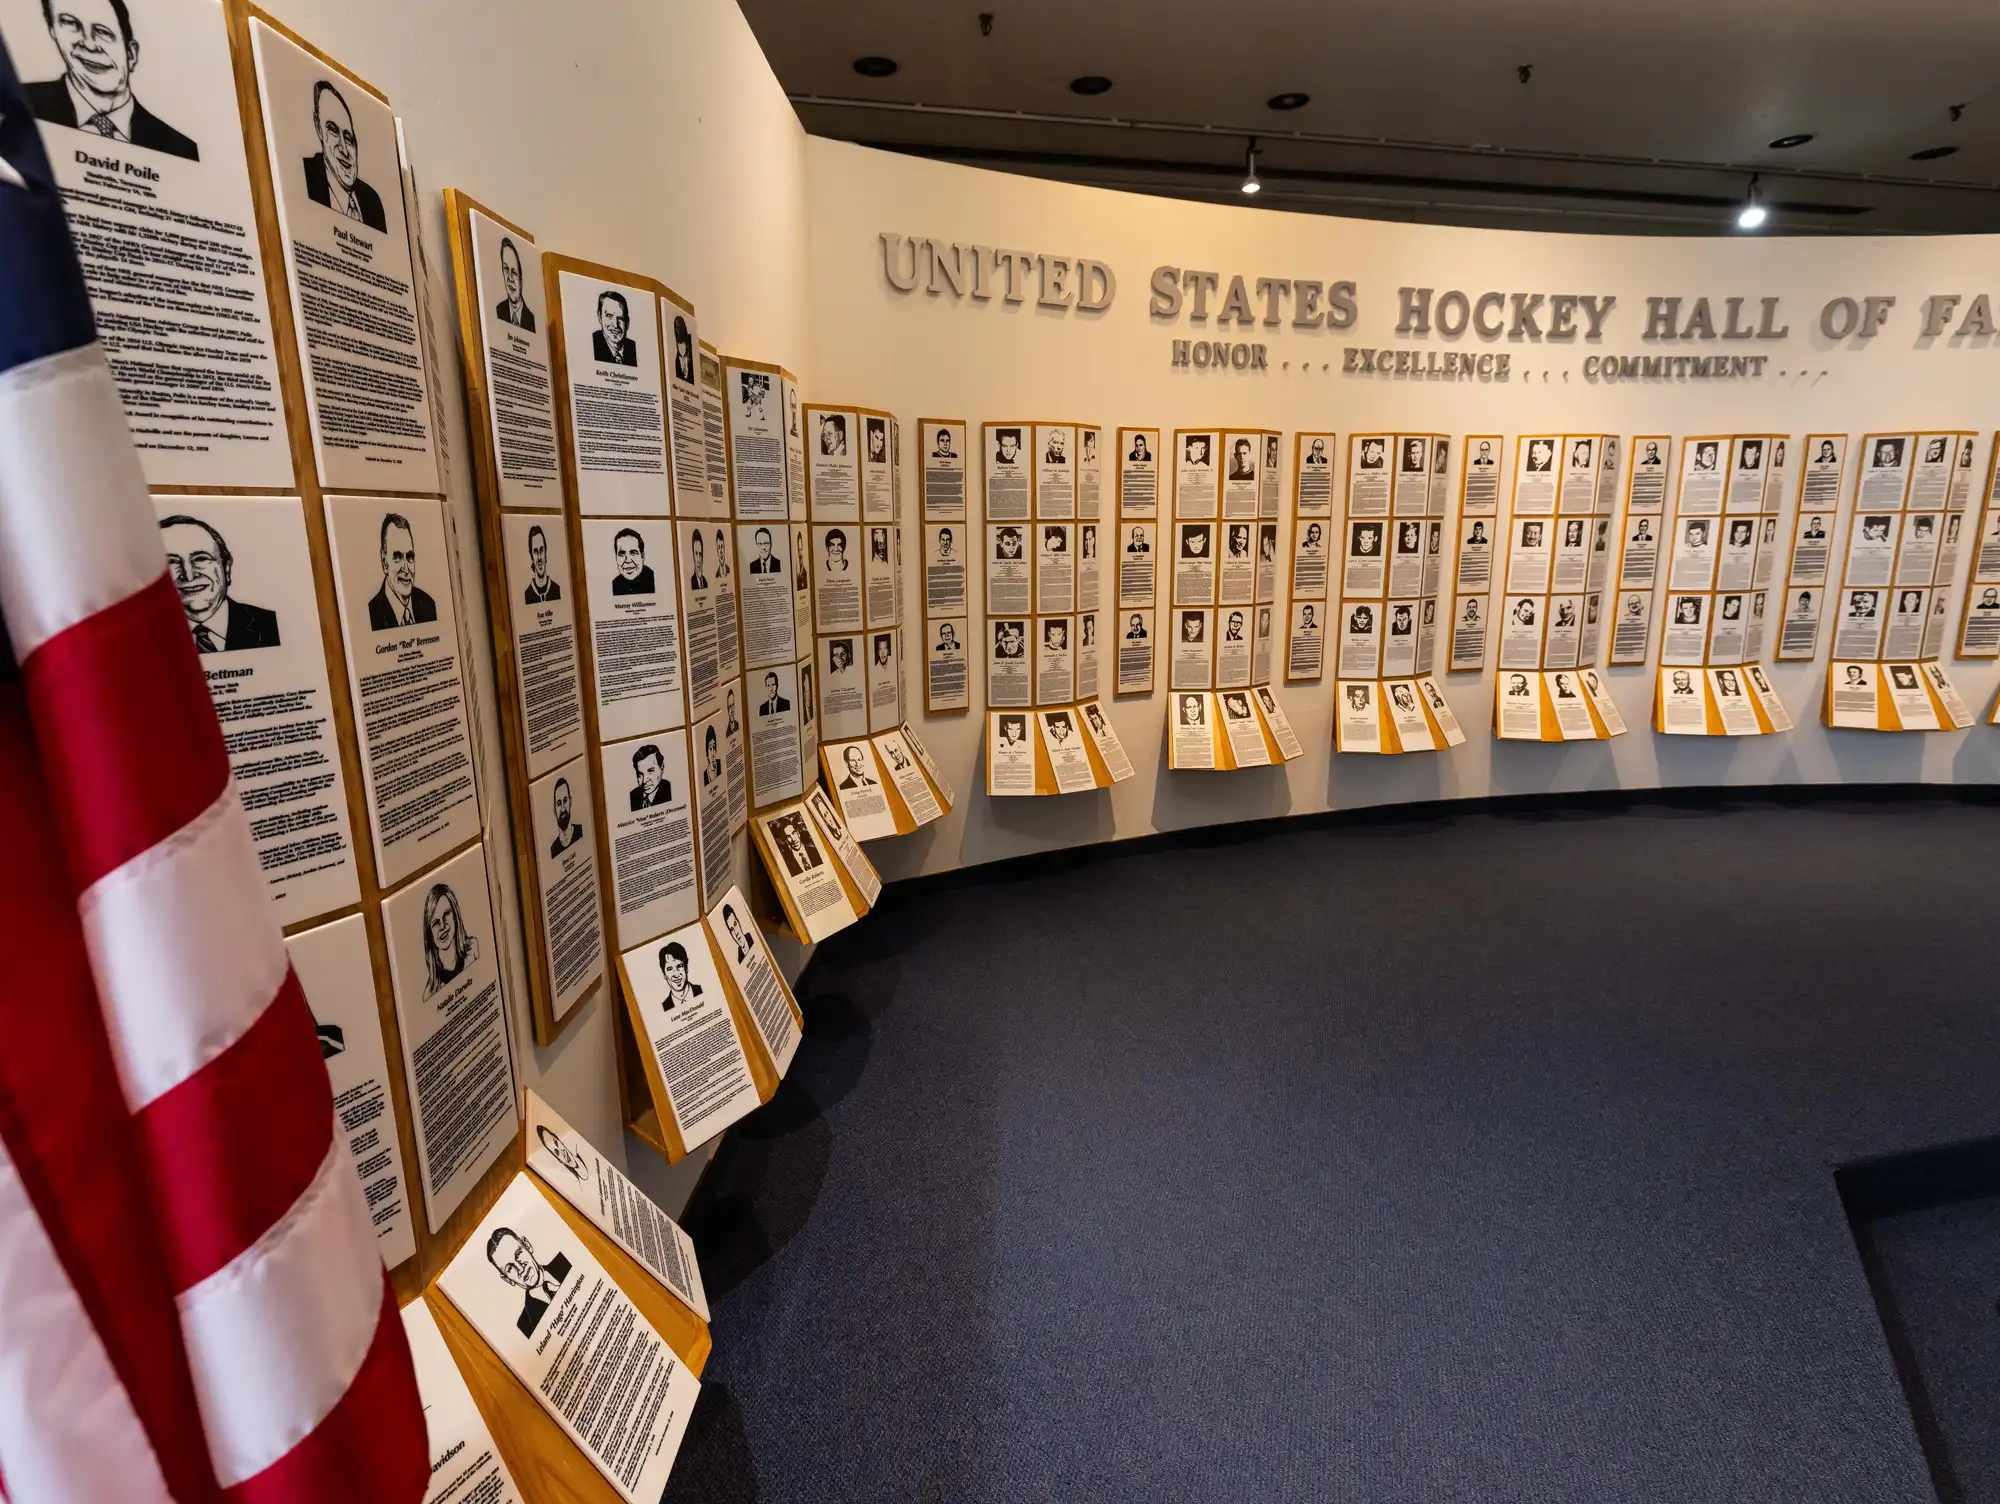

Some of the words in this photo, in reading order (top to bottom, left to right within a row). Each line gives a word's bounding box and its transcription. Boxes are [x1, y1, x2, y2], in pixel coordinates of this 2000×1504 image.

[75, 150, 120, 172] David
[124, 163, 160, 182] Poile
[102, 181, 131, 194] February
[99, 194, 122, 204] general
[169, 210, 188, 220] history
[189, 215, 213, 225] following
[333, 226, 348, 241] Paul
[349, 234, 373, 251] Stewart
[141, 244, 164, 252] General
[879, 232, 1117, 314] UNITED
[1149, 264, 1358, 329] STATES
[1394, 286, 1616, 340] HOCKEY
[1641, 296, 1789, 340] HALL
[1818, 295, 1896, 340] OF
[143, 324, 164, 332] Hockey
[158, 320, 181, 328] Advisory
[1171, 338, 1268, 370] HONOR
[1342, 347, 1511, 378] EXCELLENCE
[1582, 353, 1768, 379] COMMITMENT
[595, 369, 609, 378] Keith
[614, 602, 631, 610] Murray
[376, 643, 397, 655] Gordon
[399, 638, 415, 649] "Red"
[416, 635, 440, 646] Berenson
[205, 667, 253, 681] Bettman
[616, 819, 635, 828] Maurice
[649, 811, 665, 819] Roberts
[437, 994, 454, 1013] Natalie
[681, 1001, 705, 1017] MacDonald
[536, 1330, 552, 1356] Leland
[563, 1273, 585, 1307] Harrington
[432, 1440, 465, 1474] avidson
